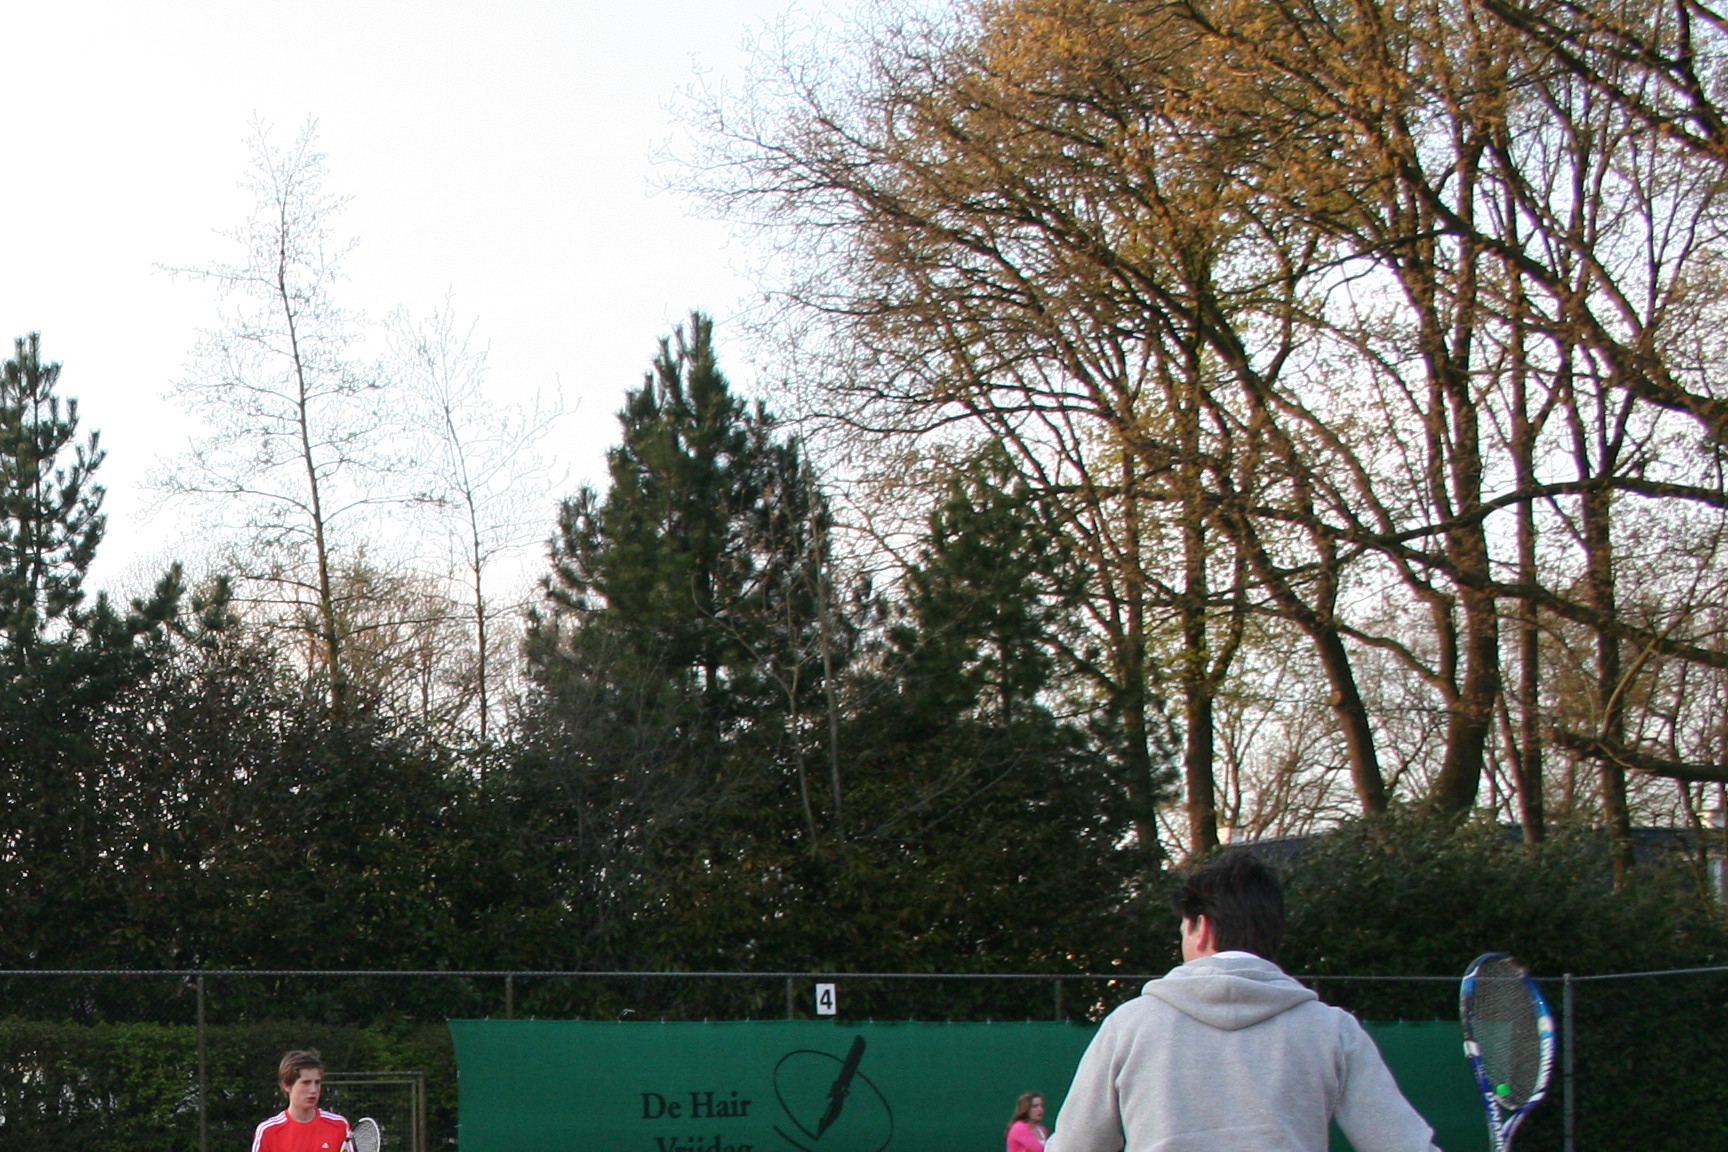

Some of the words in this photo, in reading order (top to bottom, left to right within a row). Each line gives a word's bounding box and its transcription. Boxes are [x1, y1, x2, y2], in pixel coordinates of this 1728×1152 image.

[820, 989, 833, 1010] 4
[641, 1092, 681, 1119] De
[690, 1090, 752, 1118] Hair
